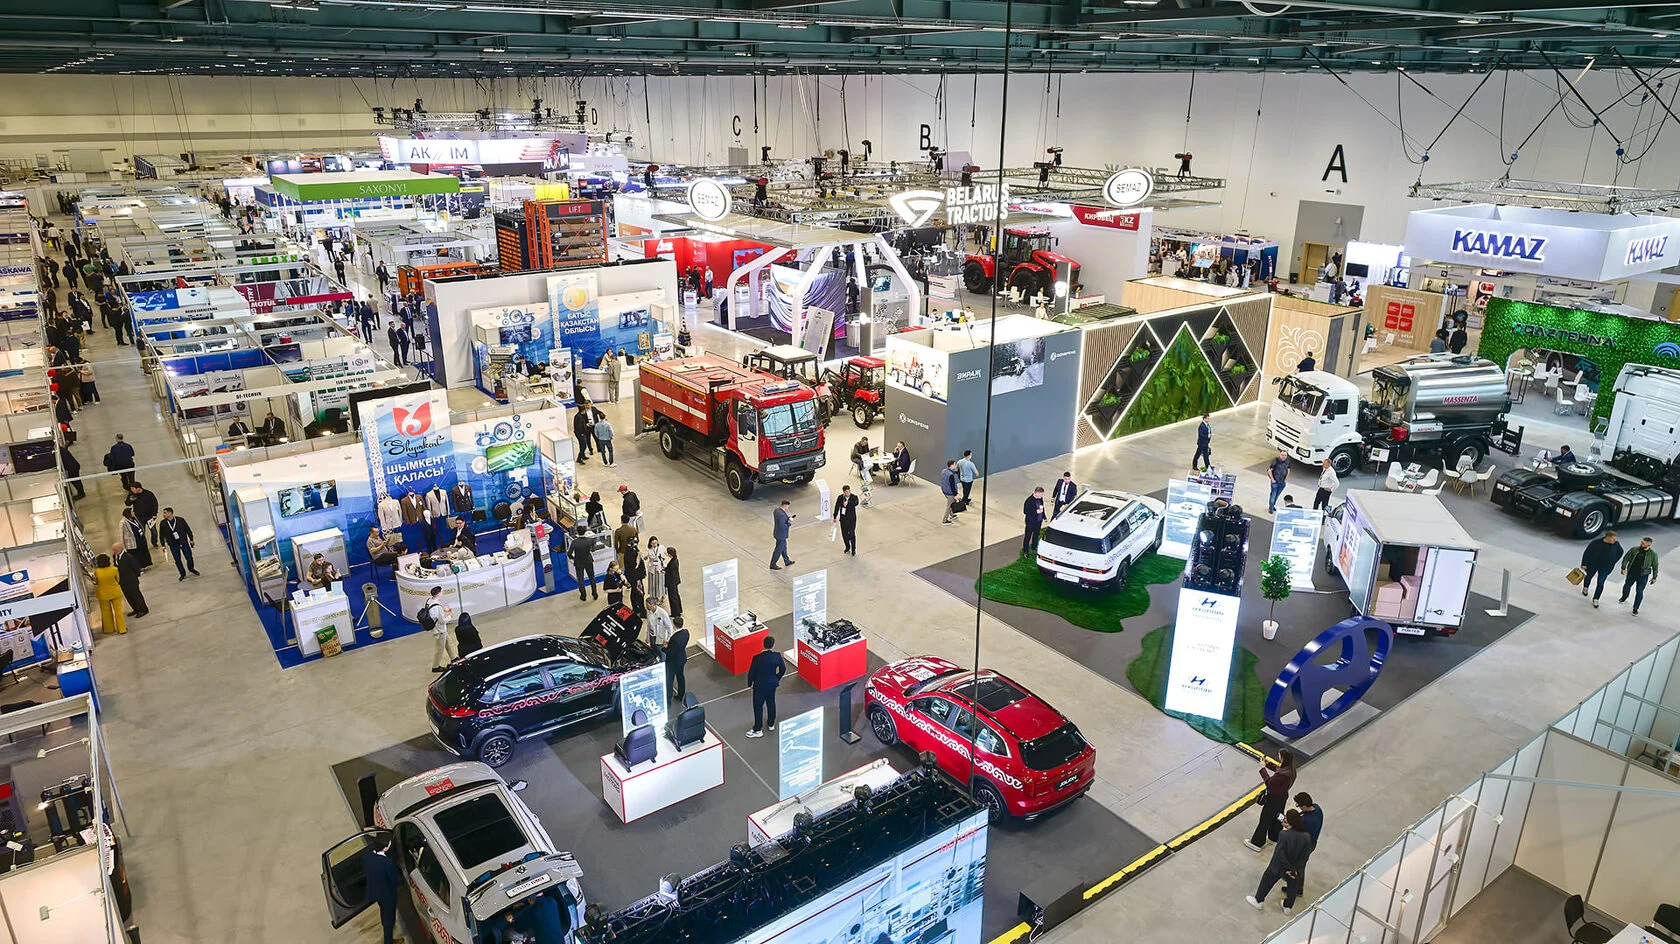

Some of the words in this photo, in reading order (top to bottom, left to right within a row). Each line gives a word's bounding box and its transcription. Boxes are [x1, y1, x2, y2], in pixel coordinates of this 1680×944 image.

[591, 107, 598, 126] D
[732, 115, 741, 136] C
[920, 123, 931, 151] B
[1321, 144, 1348, 183] A
[359, 183, 407, 195] SAXONY!
[947, 183, 1010, 206] BELARUS
[1116, 182, 1142, 194] SEMAZ
[568, 205, 582, 213] LIFT
[1452, 230, 1546, 261] KAMAZ
[1626, 235, 1668, 265] KAMAZ
[251, 299, 277, 308] MOTUL
[567, 311, 591, 320] БАТЫС
[564, 325, 596, 335] ОБЛЫСЫ
[1443, 395, 1478, 404] MASSENZA
[383, 434, 445, 459] Shymkent
[386, 454, 448, 475] ШЫМКЕНТ
[1059, 774, 1077, 788] JOLION
